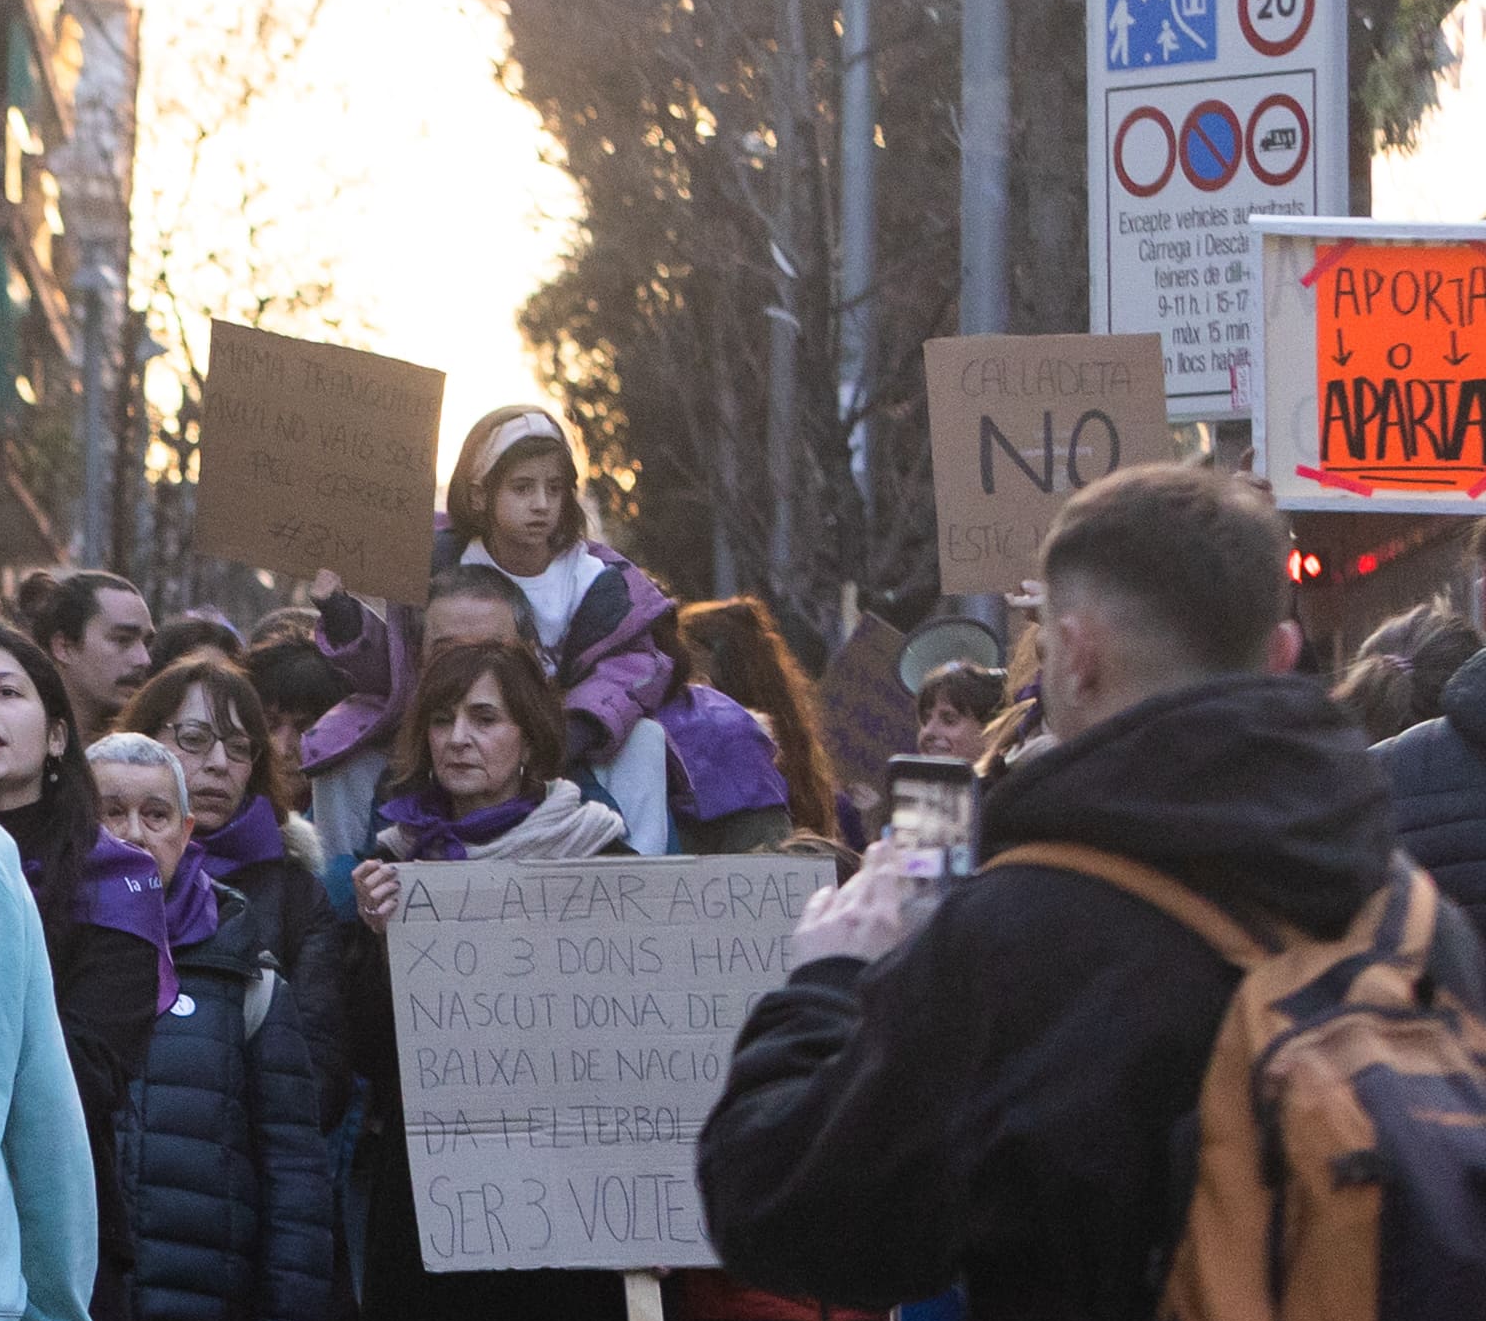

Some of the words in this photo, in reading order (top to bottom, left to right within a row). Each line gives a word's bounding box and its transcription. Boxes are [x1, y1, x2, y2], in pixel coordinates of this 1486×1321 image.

[1119, 208, 1170, 237] Excepte
[1139, 238, 1190, 262] Càrrega
[1335, 267, 1486, 327] APORTA
[1321, 376, 1486, 463] APARTA
[980, 409, 1120, 495] NO
[403, 880, 440, 923] A
[408, 938, 478, 976] XO
[508, 937, 535, 976] 3
[558, 935, 664, 976] DONS
[409, 992, 558, 1033] NASCUT
[573, 992, 672, 1032] DONA,
[688, 991, 736, 1029] DE
[417, 1048, 541, 1090] BAIXA
[551, 1050, 558, 1085] I
[573, 1048, 602, 1084] DE
[617, 1041, 720, 1083] NACIÓ
[429, 1175, 510, 1257] SER
[524, 1176, 551, 1250] 3
